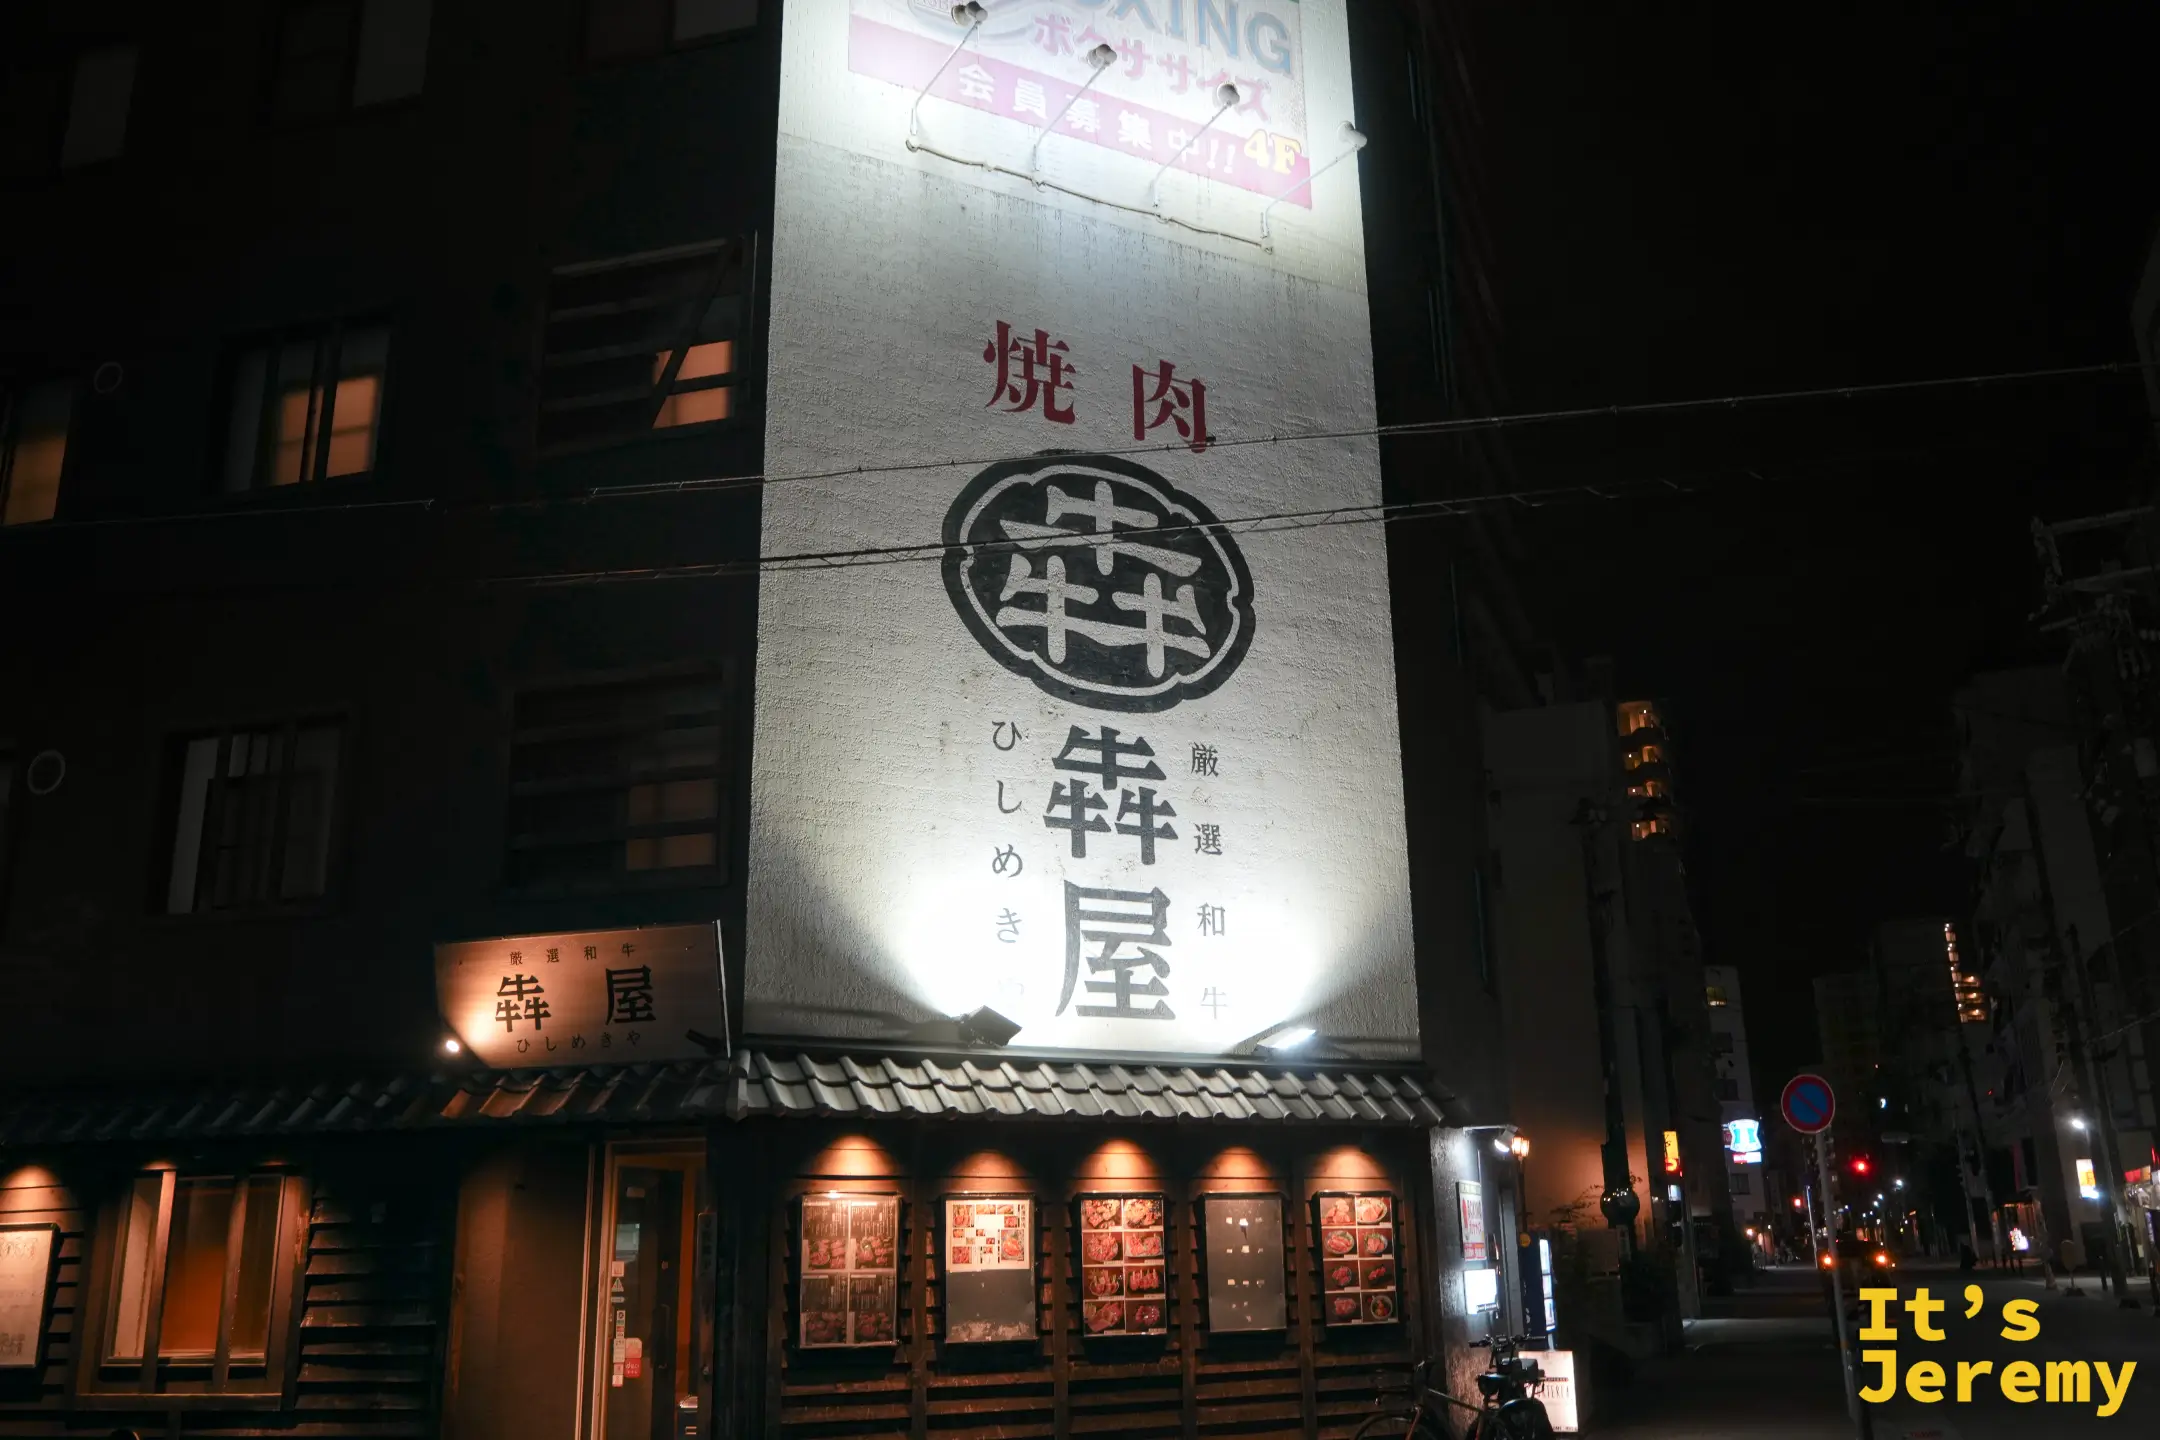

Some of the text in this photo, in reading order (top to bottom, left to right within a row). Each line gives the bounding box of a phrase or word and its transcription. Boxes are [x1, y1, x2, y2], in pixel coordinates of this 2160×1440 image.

[1076, 0, 1294, 79] XING
[1243, 128, 1303, 176] 4F
[982, 319, 1207, 454] 焼肉
[1043, 725, 1179, 1020] 犇屋
[1190, 742, 1228, 1019] 厳選和牛
[509, 942, 636, 966] 厳選和牛
[495, 965, 656, 1032] 犇屋
[517, 1030, 641, 1053] ひしめきや
